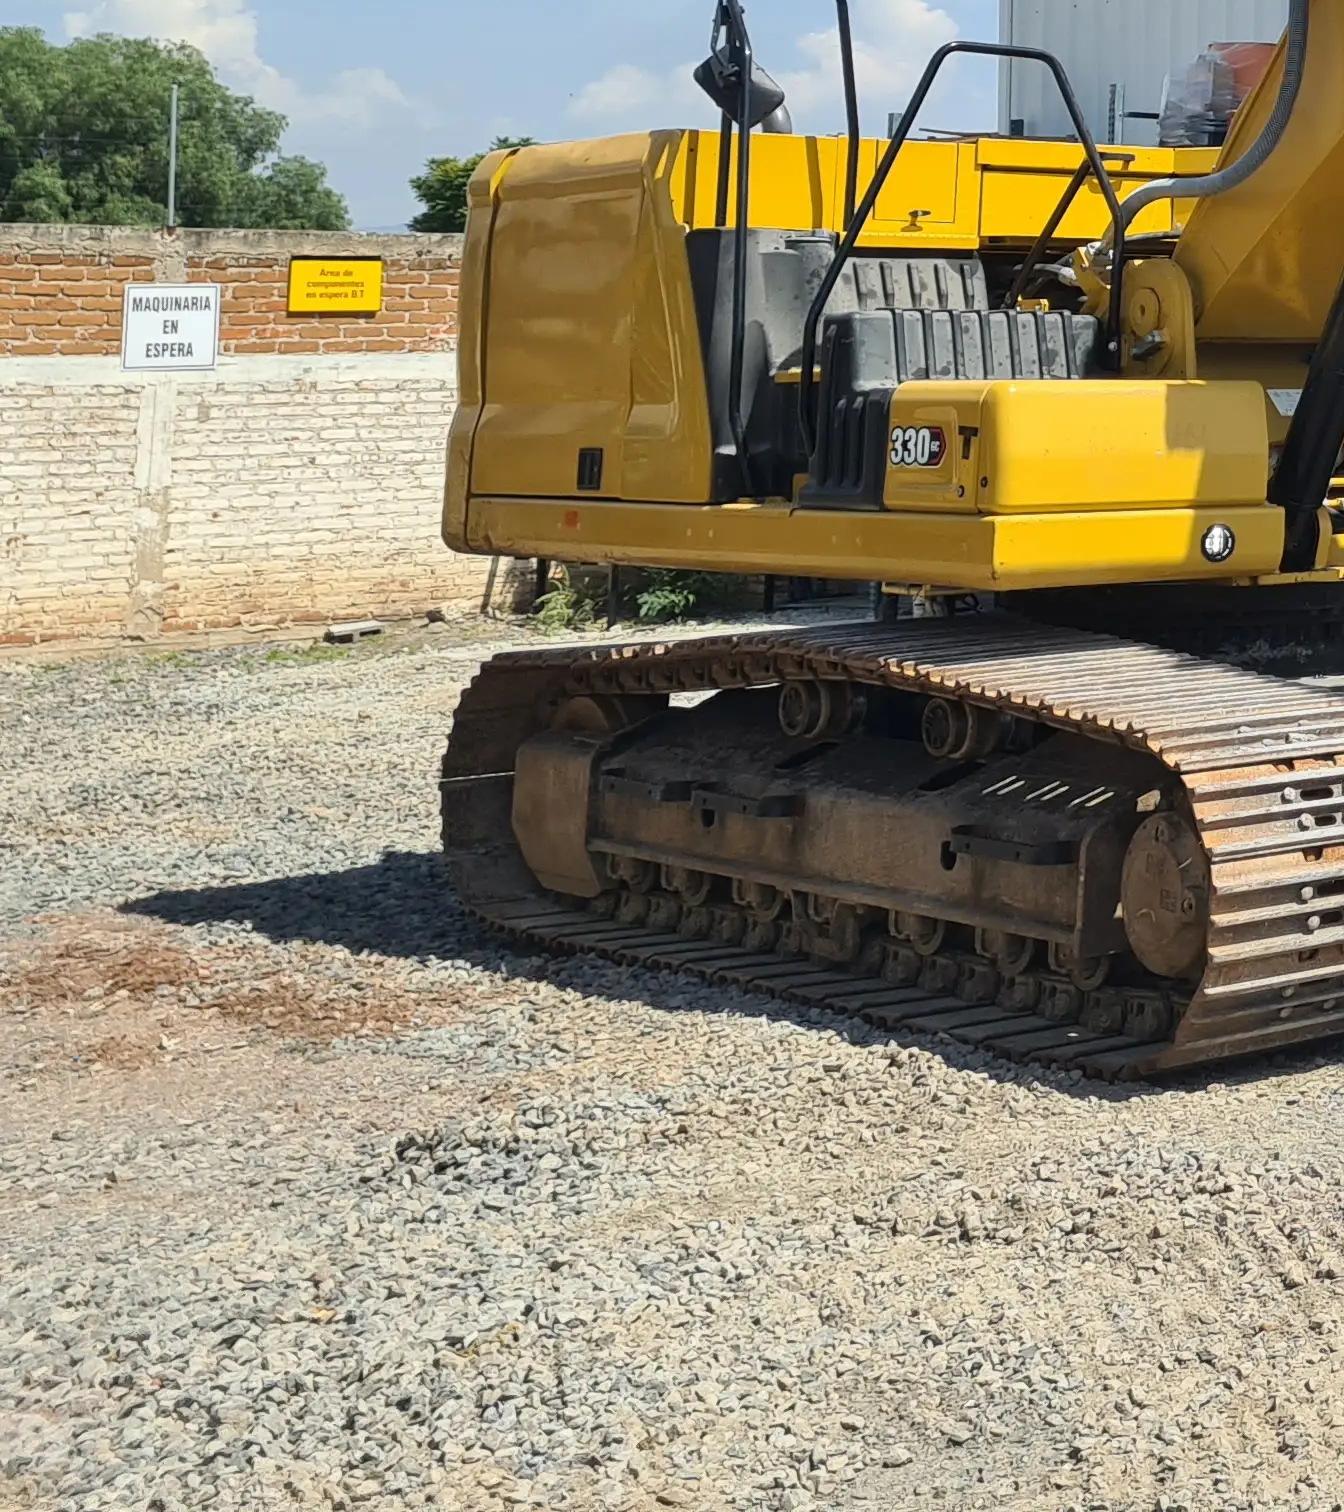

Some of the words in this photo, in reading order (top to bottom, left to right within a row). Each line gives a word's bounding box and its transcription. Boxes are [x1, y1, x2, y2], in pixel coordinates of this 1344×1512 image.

[132, 295, 212, 314] MAQUINARIA
[162, 319, 179, 335] EN
[145, 342, 194, 359] ESPERA
[890, 427, 931, 464] 330
